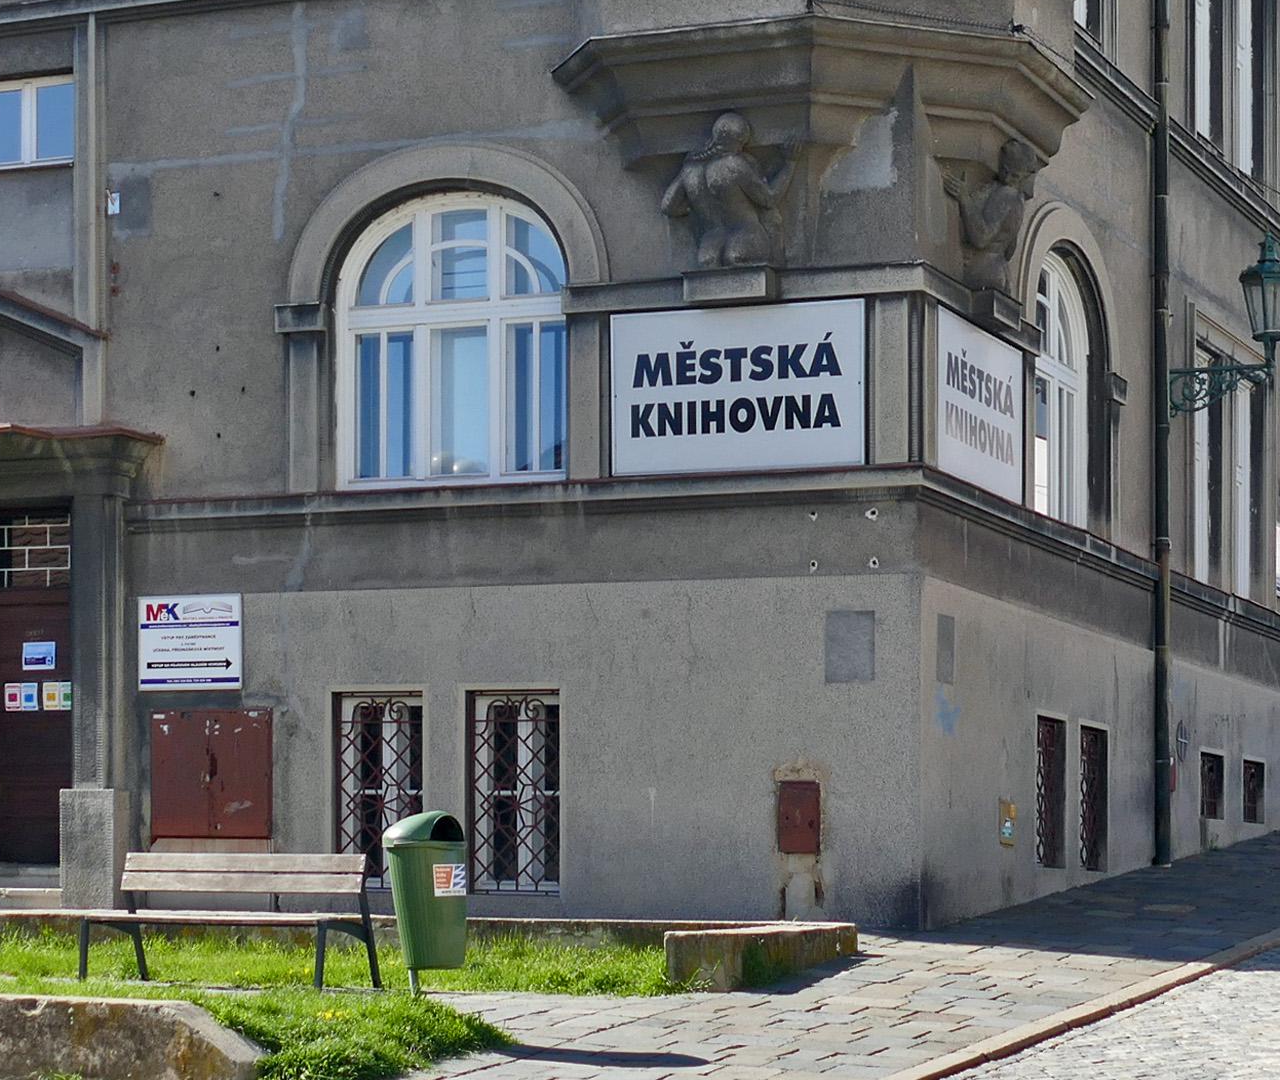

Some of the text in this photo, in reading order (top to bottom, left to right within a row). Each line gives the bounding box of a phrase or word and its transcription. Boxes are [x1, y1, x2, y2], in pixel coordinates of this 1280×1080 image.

[632, 331, 843, 389] MĚSTSKÁ
[946, 348, 1015, 419] MĚSTSKÁ
[630, 393, 842, 439] KNIHOVNA
[945, 400, 1015, 467] KNIHOVNA
